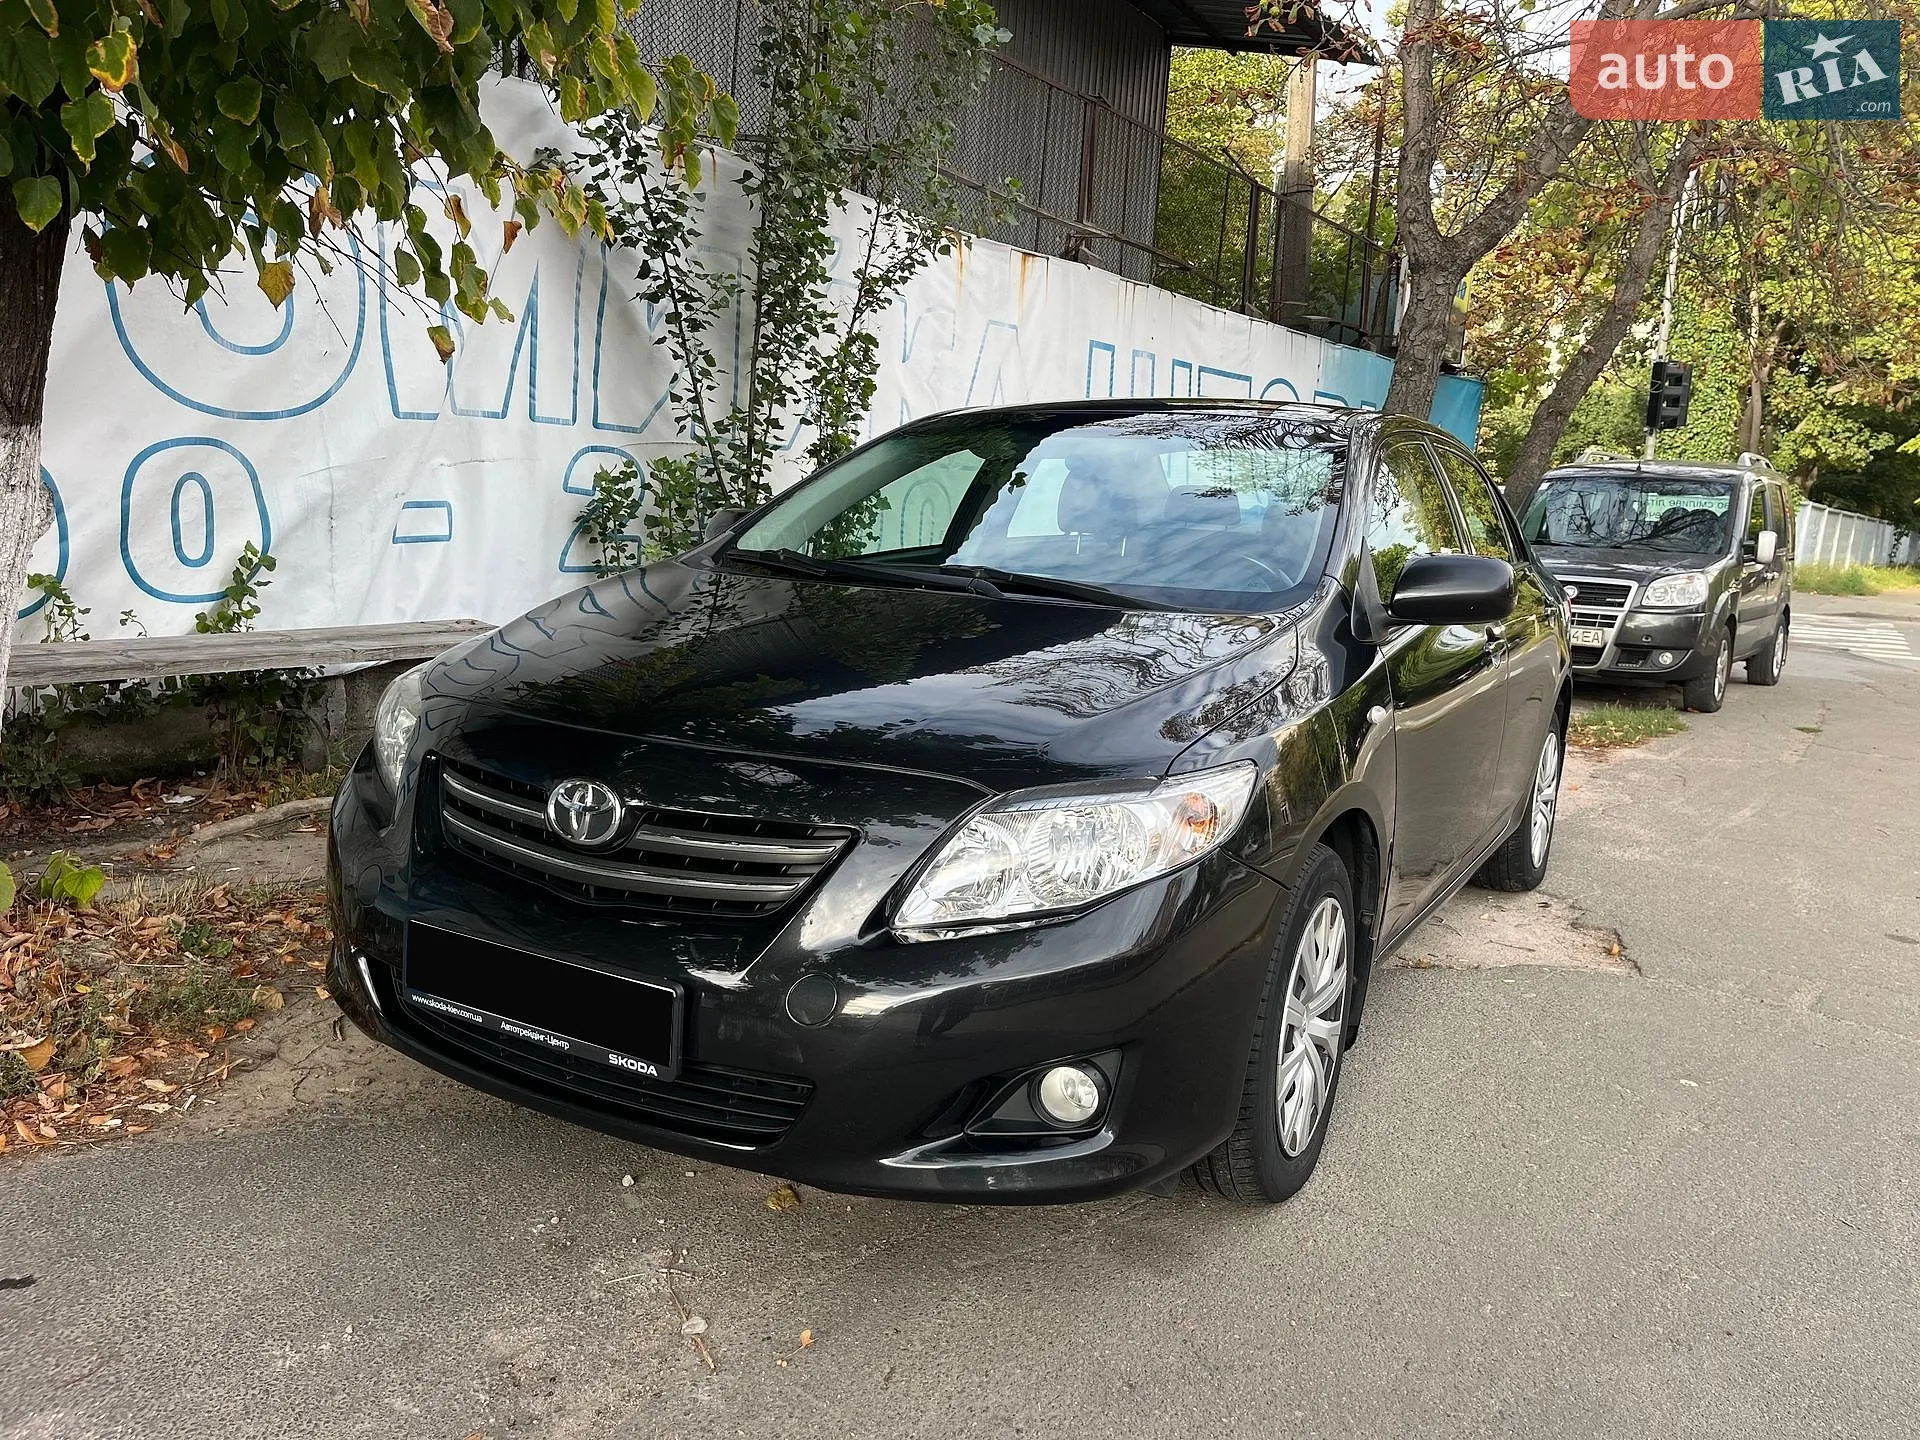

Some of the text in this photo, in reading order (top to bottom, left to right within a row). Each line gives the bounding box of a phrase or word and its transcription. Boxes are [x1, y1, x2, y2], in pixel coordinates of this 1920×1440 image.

[411, 994, 483, 1023] www.skoda-kiev.com.ua
[500, 1020, 570, 1050] Автотрейдінг-Центр
[608, 1053, 658, 1077] SKODA
